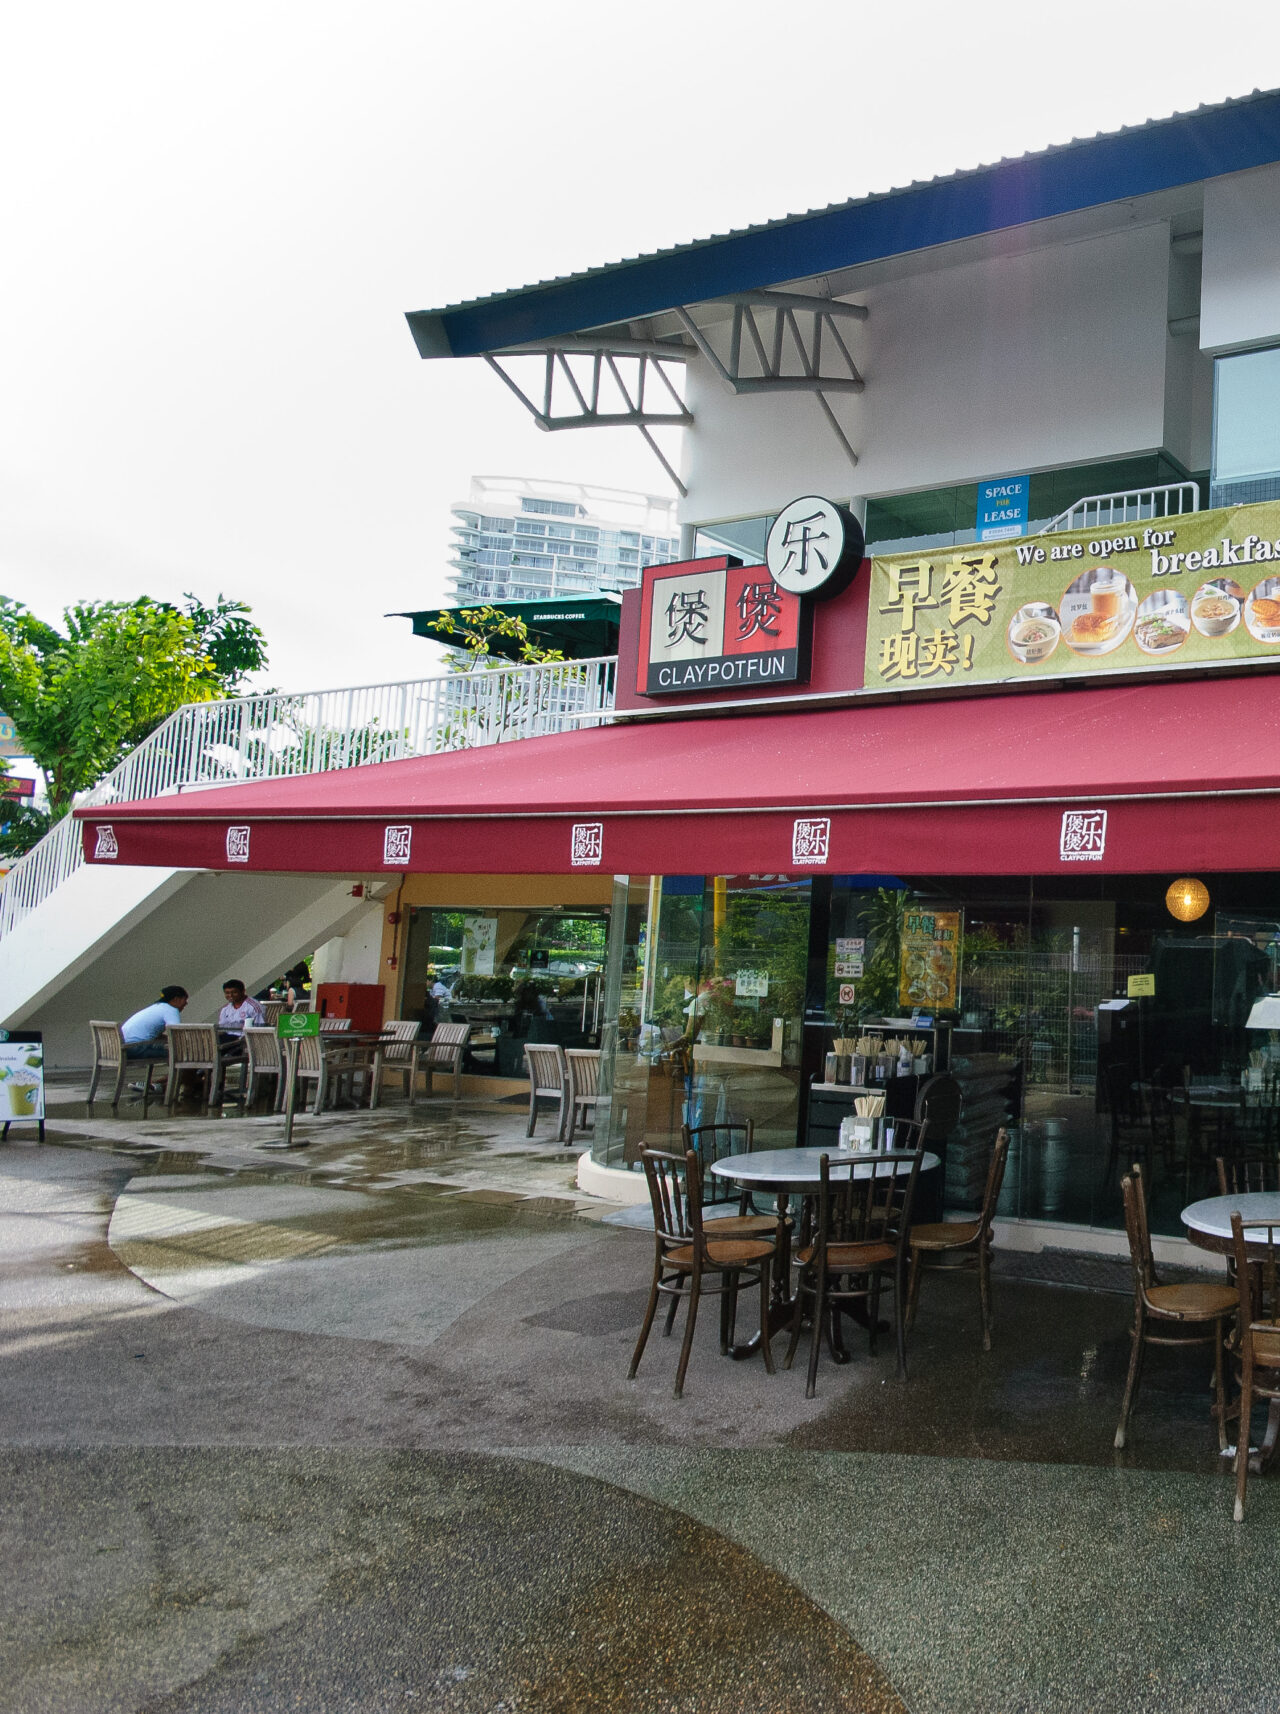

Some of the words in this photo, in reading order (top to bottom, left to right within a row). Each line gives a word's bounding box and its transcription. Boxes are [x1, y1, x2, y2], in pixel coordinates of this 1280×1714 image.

[985, 484, 1022, 499] SPACE
[984, 508, 1021, 523] LEASE
[778, 511, 829, 576] 乐
[1015, 545, 1046, 565] We
[1050, 544, 1083, 560] are
[1088, 534, 1137, 558] open
[1142, 528, 1176, 548] for
[878, 552, 1002, 634] 早餐
[658, 655, 785, 686] CLAYPOTFUN
[1060, 853, 1103, 861] CLAYPOTFUN
